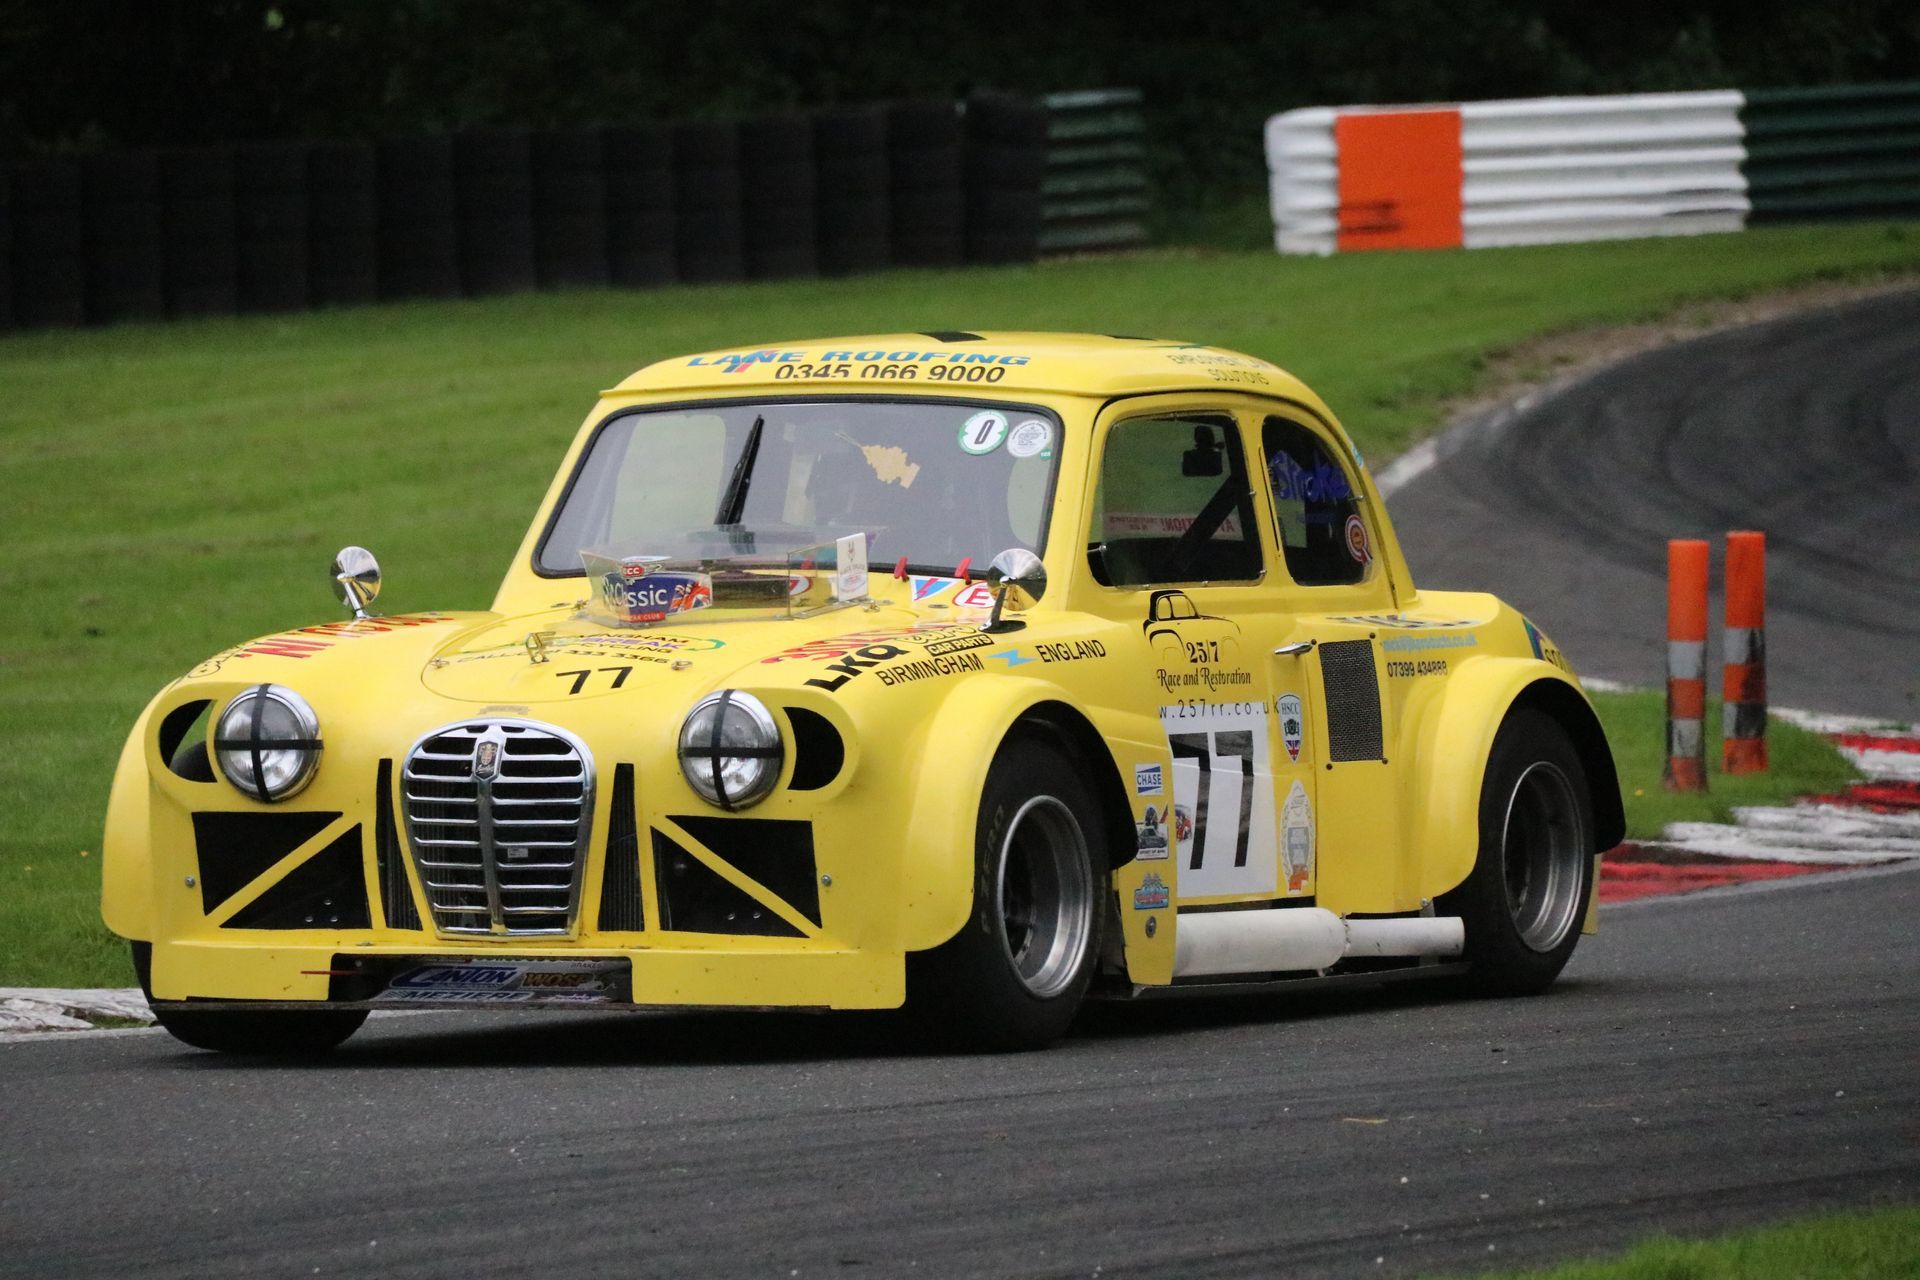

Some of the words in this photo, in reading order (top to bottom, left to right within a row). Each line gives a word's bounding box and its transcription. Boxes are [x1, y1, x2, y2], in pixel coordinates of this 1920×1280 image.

[688, 350, 805, 373] LANE
[820, 351, 1032, 366] ROOFING
[774, 364, 851, 380] 0345
[861, 365, 919, 380] 066
[927, 364, 1006, 383] 9000
[581, 642, 673, 654] CYCLING
[928, 643, 952, 656] CAR
[952, 634, 992, 652] PARTS
[1035, 639, 1106, 663] ENGLAND
[803, 644, 909, 692] LKQ
[875, 653, 985, 687] BIRMINGHAM
[1156, 668, 1181, 693] Race
[1183, 669, 1199, 686] and
[1200, 667, 1251, 692] Restoration
[556, 666, 633, 695] 77
[1281, 702, 1299, 716] HSCC
[1136, 773, 1162, 786] CHASE
[1168, 730, 1255, 870] 77
[391, 964, 518, 988] CANTON
